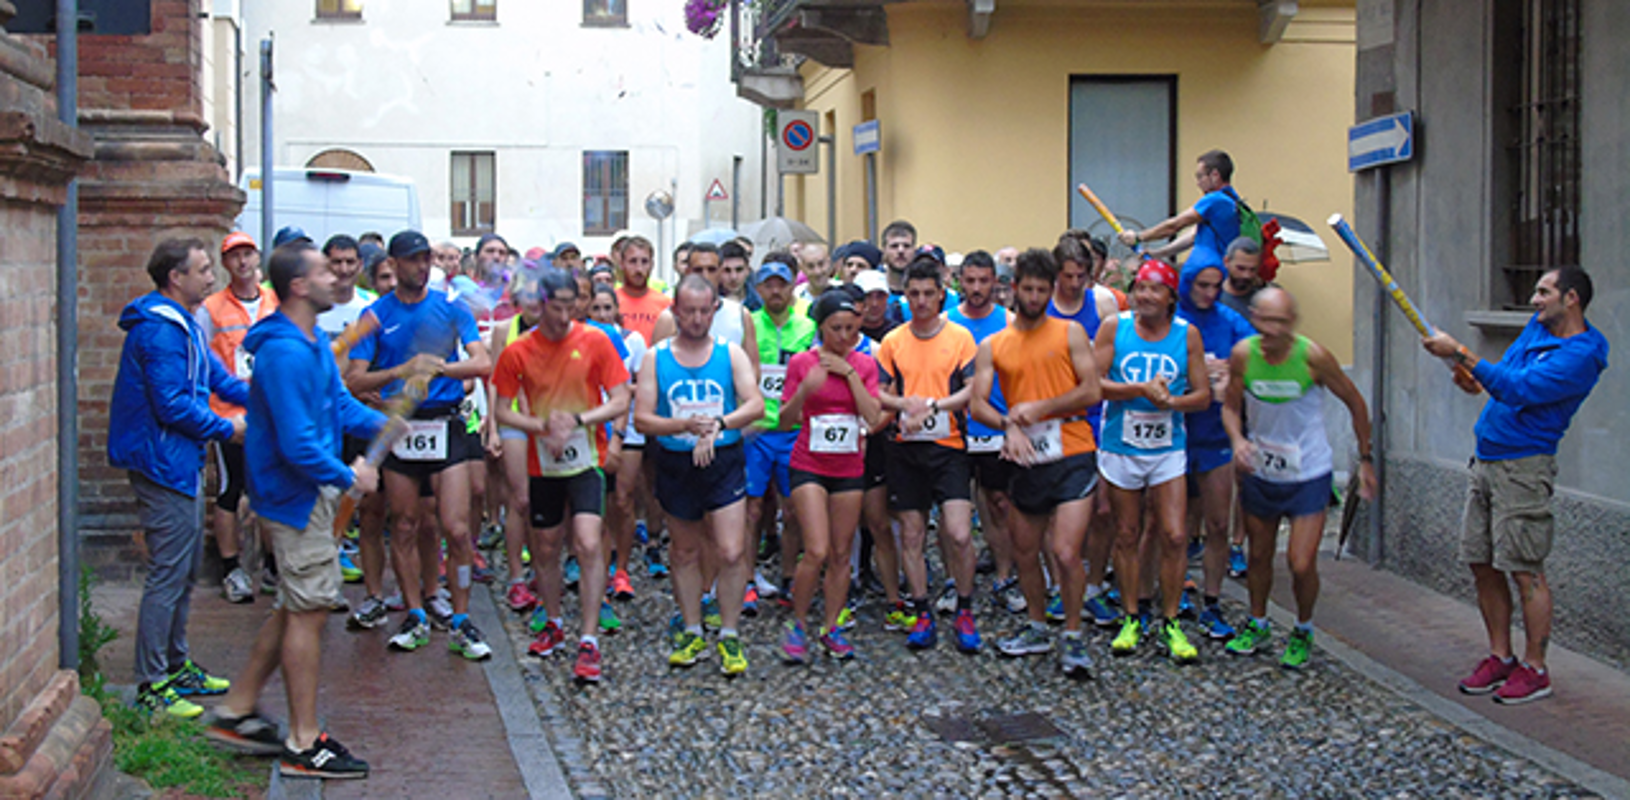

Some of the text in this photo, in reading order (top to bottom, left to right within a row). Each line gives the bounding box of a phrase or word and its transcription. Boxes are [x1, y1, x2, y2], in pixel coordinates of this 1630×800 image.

[763, 376, 784, 391] 62
[824, 426, 849, 442] 67
[1133, 422, 1166, 439] 175
[404, 434, 437, 451] 161
